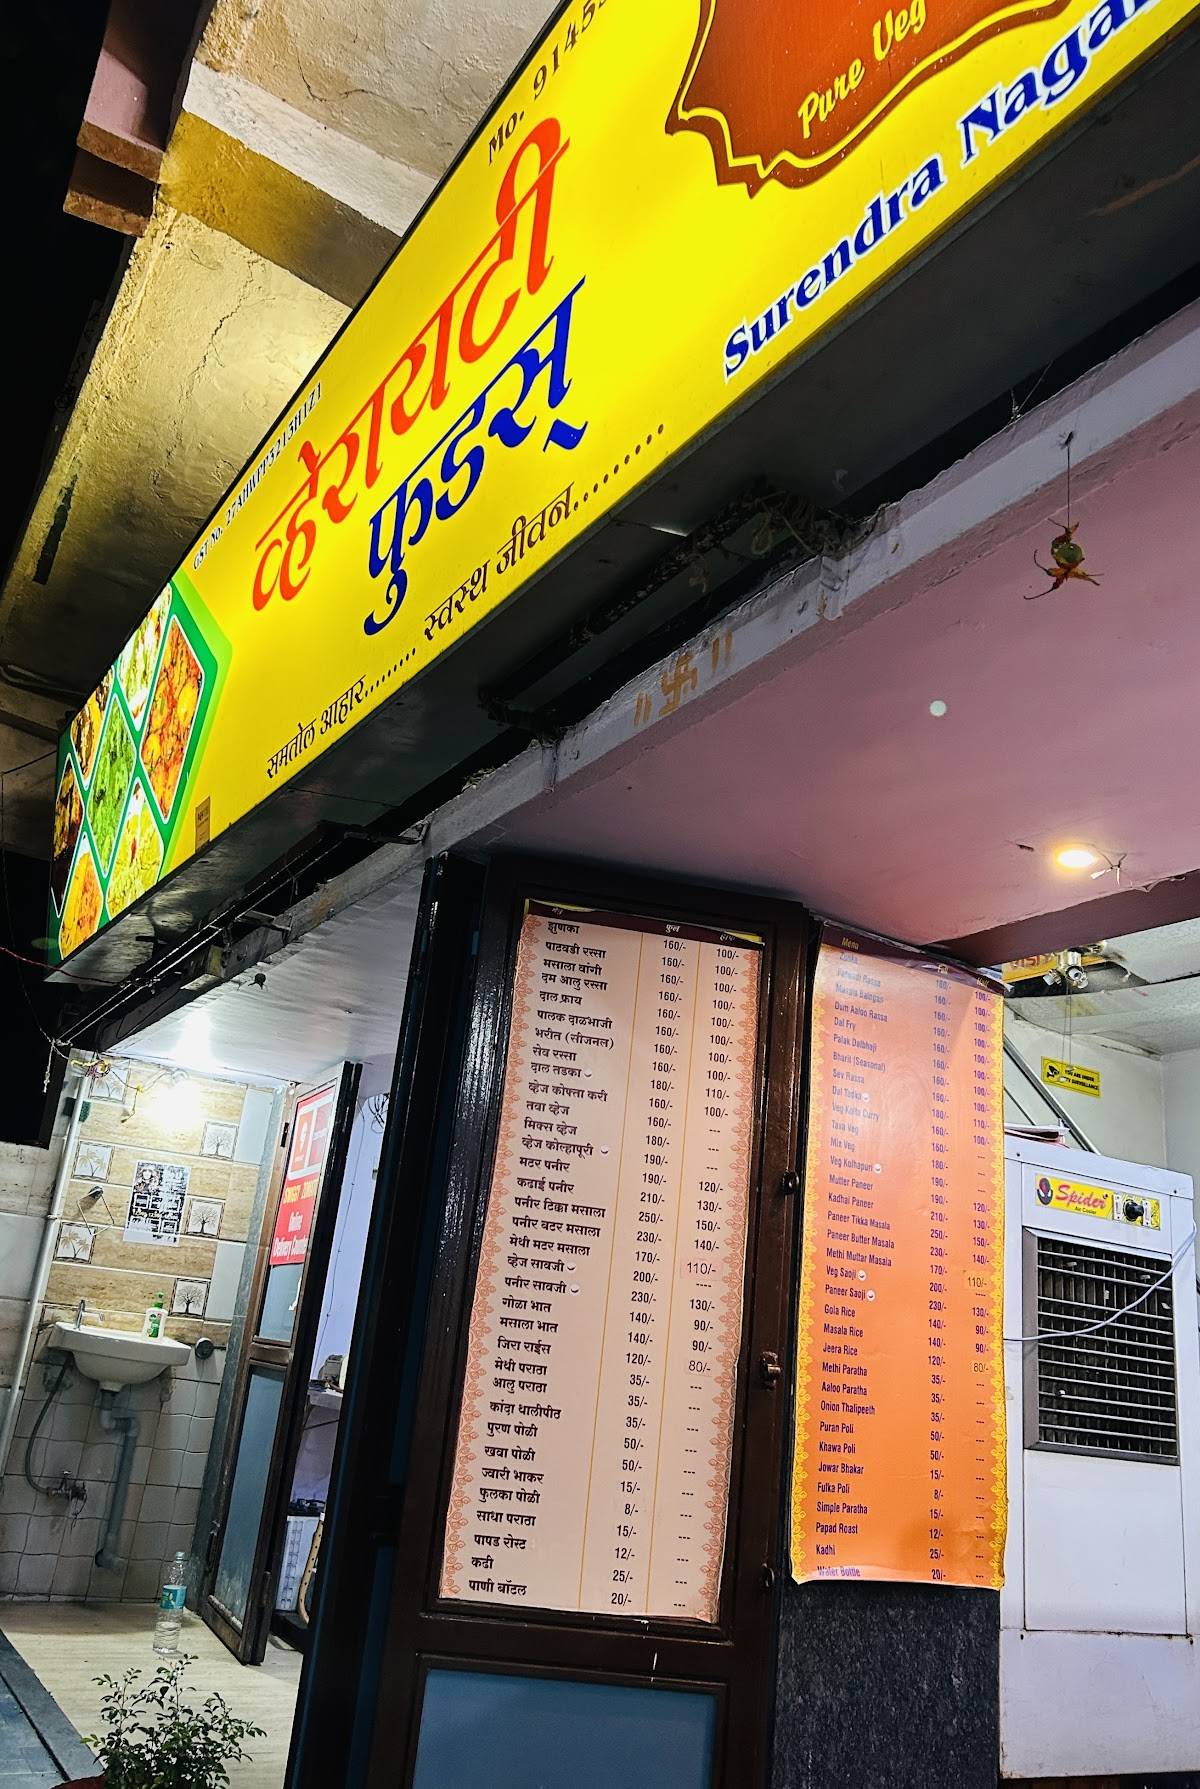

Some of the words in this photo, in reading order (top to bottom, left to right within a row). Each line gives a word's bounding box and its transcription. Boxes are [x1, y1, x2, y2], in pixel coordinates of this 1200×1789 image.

[489, 110, 525, 166] Mo.
[533, 0, 607, 100] 9145
[798, 58, 865, 139] Pure
[873, 0, 926, 61] Veg
[725, 157, 945, 377] Surendra
[193, 540, 209, 570] GST
[267, 718, 317, 778] समतोल
[424, 560, 490, 641] स्वस्थ
[547, 921, 580, 934] झुणका
[663, 939, 686, 951] 160/-
[716, 948, 739, 960] 100/-
[841, 937, 859, 950] Menu
[543, 958, 576, 971] मसाला
[578, 962, 602, 975] वांगी
[660, 973, 683, 986] 160/-
[714, 982, 736, 993] 100/-
[539, 990, 559, 1002] दाल
[559, 994, 583, 1005] फ्राय
[658, 1008, 680, 1020] 160/-
[711, 1016, 734, 1029] 100/-
[534, 1027, 562, 1040] भरीत
[653, 1043, 677, 1055] 160/-
[708, 1051, 731, 1064] 100/-
[530, 1061, 550, 1073] दाल
[650, 1079, 674, 1091] 180/-
[705, 1087, 729, 1100] 110/-
[526, 1100, 546, 1112] तवा
[548, 1100, 570, 1116] व्हेज
[647, 1116, 671, 1128] 160/-
[521, 1134, 543, 1150] व्हेज
[644, 1153, 668, 1166] 190/-
[519, 1156, 542, 1168] मटर
[544, 1158, 570, 1172] पनीर
[642, 1172, 666, 1185] 190/-
[698, 1181, 723, 1193] 120/-
[548, 1179, 574, 1193] पनीर
[640, 1191, 665, 1205] 210/-
[697, 1199, 722, 1212] 130/-
[851, 1178, 873, 1190] Paneer
[930, 1194, 948, 1205] 190/-
[973, 1202, 990, 1213] 120/-
[1056, 1184, 1105, 1209] Spider
[514, 1195, 541, 1209] पनीर
[570, 1204, 606, 1218] मसाला
[638, 1211, 663, 1224] 250/-
[695, 1219, 720, 1232] 150/-
[827, 1210, 850, 1222] Paneer
[851, 1214, 868, 1226] Tikka
[869, 1218, 890, 1230] Masala
[930, 1228, 948, 1240] 250/-
[972, 1236, 990, 1248] 150/-
[827, 1228, 849, 1241] Paneer
[850, 1232, 870, 1245] Butter
[871, 1236, 894, 1249] Masala
[930, 1246, 948, 1257] 230/-
[972, 1253, 989, 1265] 140/-
[504, 1275, 530, 1289] पनीर
[532, 1280, 567, 1293] सावजी
[631, 1290, 656, 1304] 230/-
[689, 1298, 715, 1312] 130/-
[826, 1264, 838, 1278] Veg
[929, 1281, 947, 1294] 200/-
[499, 1316, 534, 1330] मसाला
[536, 1320, 558, 1333] भात
[627, 1331, 653, 1345] 140/-
[692, 1339, 712, 1352] 90/-
[824, 1303, 839, 1315] Gola
[840, 1306, 855, 1317] Rice
[928, 1318, 946, 1329] 140/-
[975, 1324, 988, 1336] 90/-
[497, 1335, 521, 1350] जिरा
[625, 1352, 651, 1366] 120/-
[688, 1359, 711, 1372] 80/-
[823, 1322, 847, 1335] Masala
[849, 1326, 863, 1337] Rice
[927, 1336, 946, 1348] 140/-
[975, 1343, 989, 1354] 90/-
[821, 1361, 840, 1373] Methi
[842, 1363, 867, 1376] Paratha
[931, 1374, 946, 1384] 35/-
[820, 1399, 839, 1412] Onion
[930, 1411, 944, 1423] 35/-
[486, 1421, 511, 1437] पुरण
[513, 1421, 538, 1437] पोळी
[623, 1437, 644, 1450] 50/-
[819, 1420, 839, 1432] Puran
[841, 1422, 854, 1433] Poli
[930, 1430, 944, 1442] 50/-
[843, 1442, 855, 1454] Poli
[930, 1449, 944, 1461] 50/-
[513, 1469, 544, 1484] भाकर
[620, 1480, 640, 1494] 15/-
[817, 1481, 835, 1493] Fulka
[837, 1482, 850, 1494] Poli
[933, 1488, 943, 1501] 8/-
[478, 1487, 513, 1503] फुलका
[515, 1487, 540, 1504] पोळी
[624, 1503, 638, 1516] 8/-
[816, 1501, 840, 1515] Simple
[841, 1502, 867, 1514] Paratha
[929, 1508, 943, 1520] 15/-
[473, 1534, 500, 1547] पापड
[503, 1533, 527, 1549] रोस्ट
[614, 1546, 635, 1560] 12/-
[815, 1521, 836, 1535] Papad
[838, 1522, 858, 1534] Roast
[928, 1528, 944, 1540] 12/-
[815, 1543, 835, 1555] Kadhi
[929, 1548, 944, 1560] 25/-
[612, 1569, 633, 1583] 25/-
